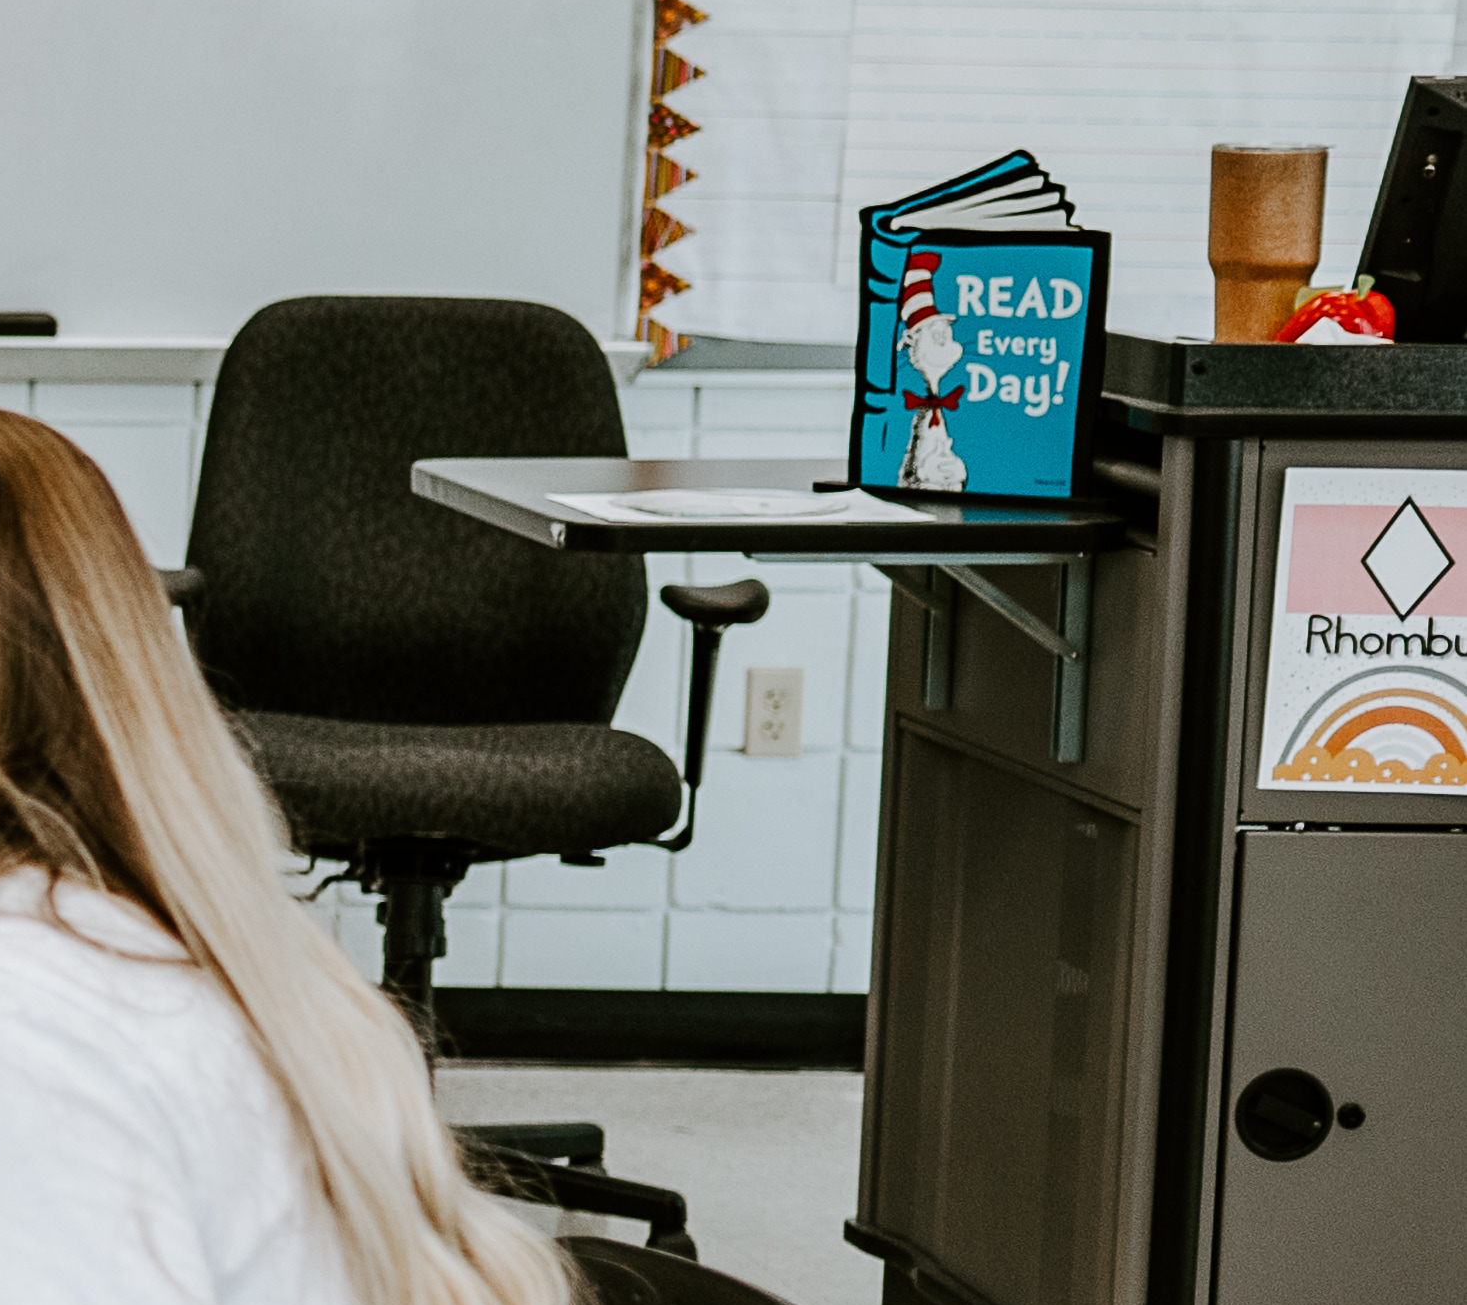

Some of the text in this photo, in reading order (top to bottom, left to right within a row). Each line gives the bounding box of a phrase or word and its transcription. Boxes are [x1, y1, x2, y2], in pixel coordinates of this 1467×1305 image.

[956, 274, 1084, 320] READ
[976, 328, 1058, 365] Every
[965, 360, 1071, 417] Day!
